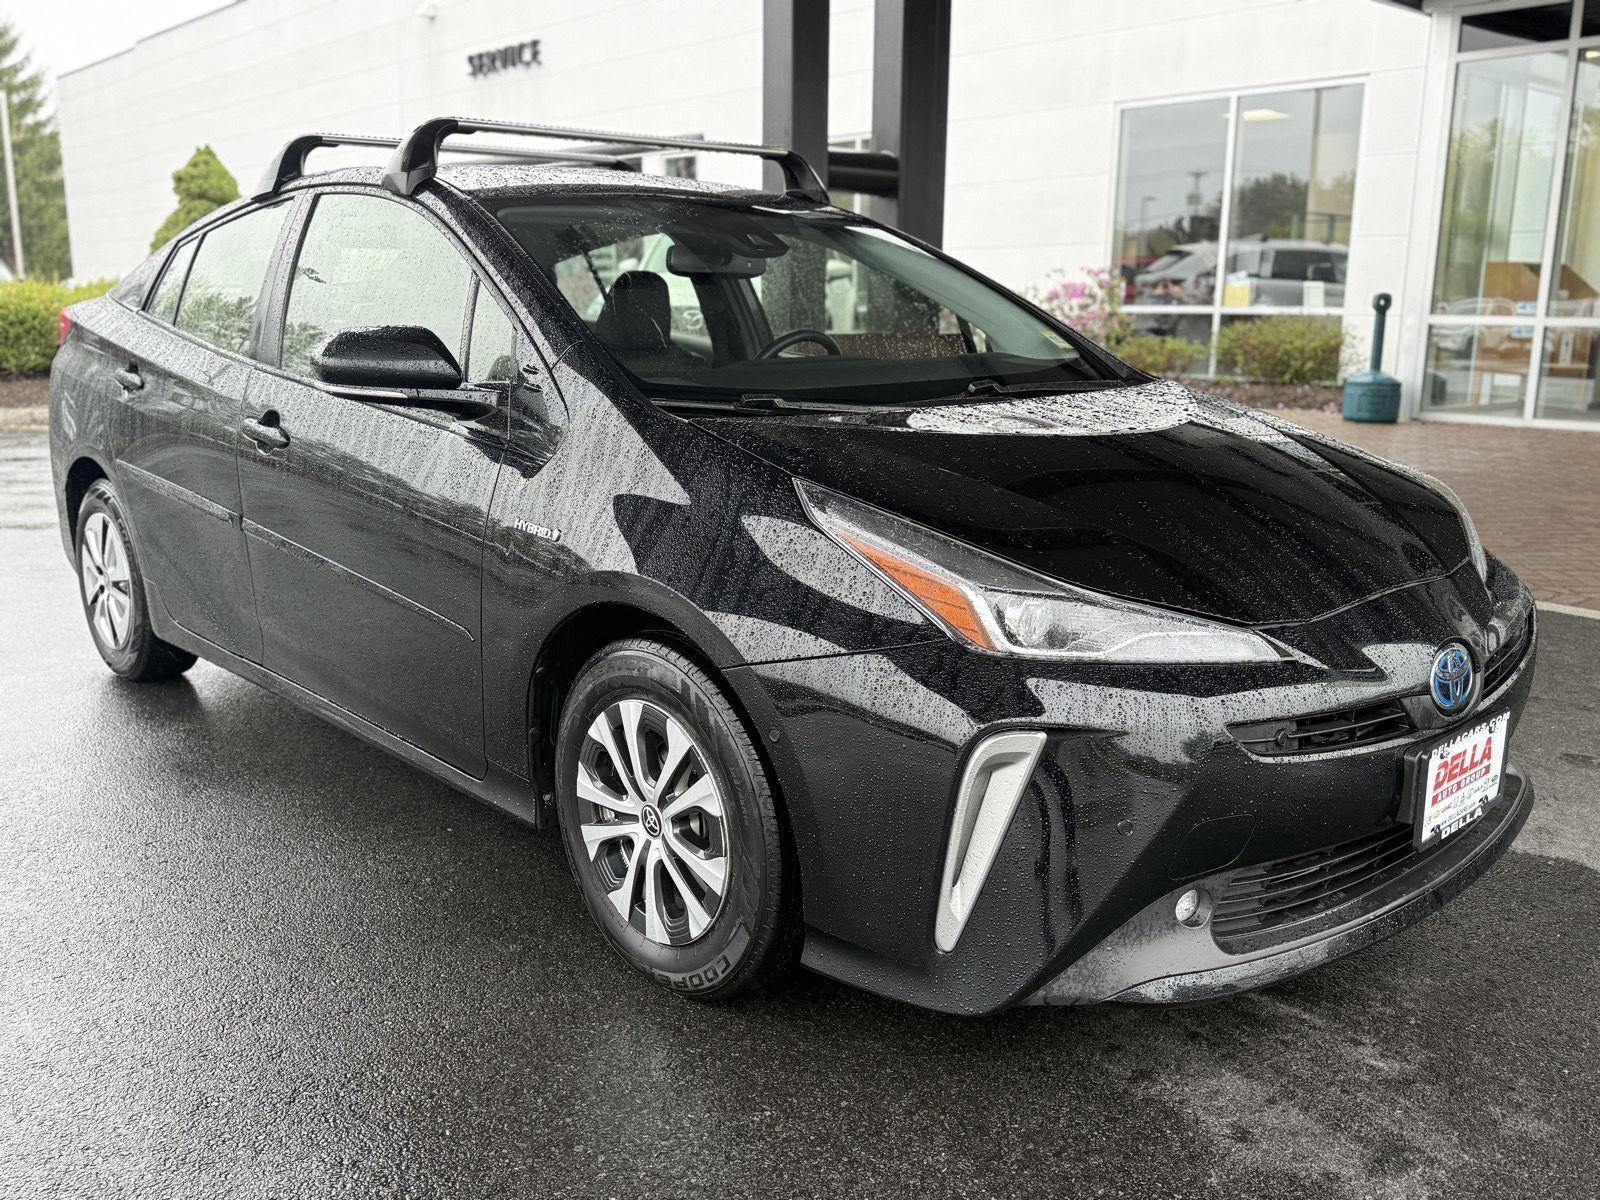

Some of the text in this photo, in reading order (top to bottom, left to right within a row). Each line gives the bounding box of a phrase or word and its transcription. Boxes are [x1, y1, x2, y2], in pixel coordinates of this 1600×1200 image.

[467, 38, 542, 77] SERVICE
[514, 518, 551, 540] HYBRID
[1431, 711, 1510, 758] DELLACARS.COM
[1433, 736, 1492, 791] DELLA
[1437, 783, 1458, 803] AUTO
[1460, 766, 1486, 788] GROUP
[1441, 806, 1483, 840] DELLA
